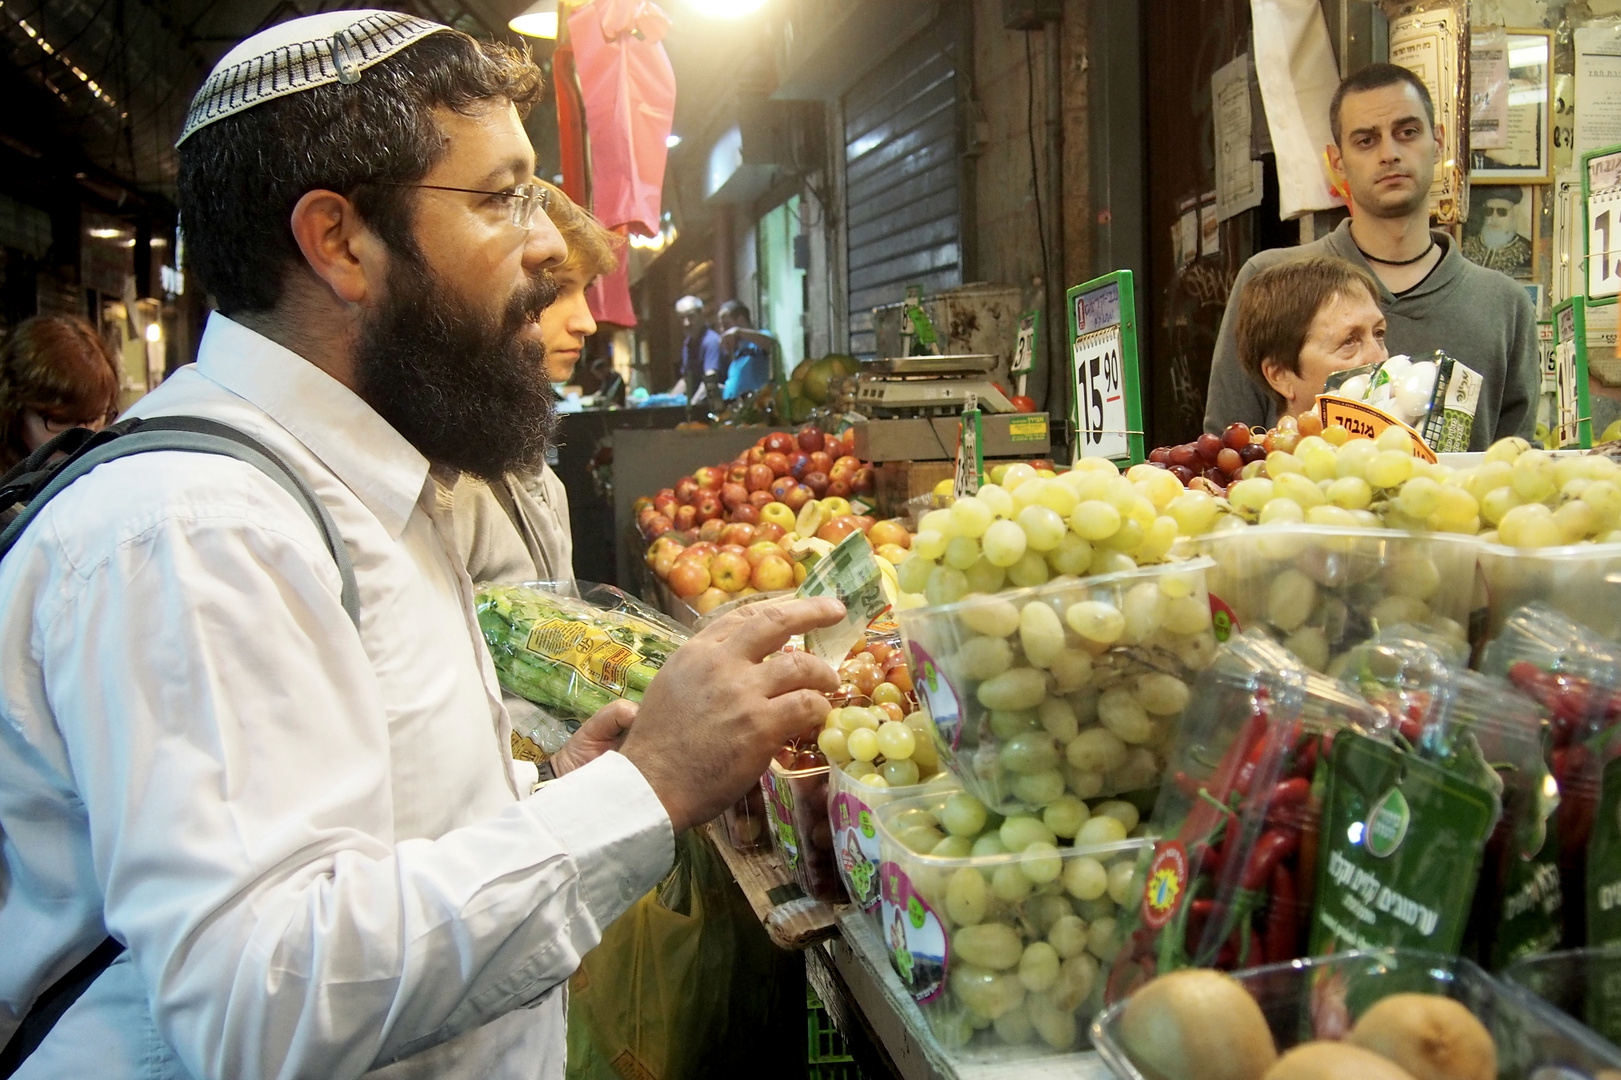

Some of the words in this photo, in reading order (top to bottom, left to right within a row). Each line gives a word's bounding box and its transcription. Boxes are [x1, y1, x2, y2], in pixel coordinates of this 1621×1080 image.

[1594, 209, 1621, 282] 1
[1078, 355, 1104, 446] 15
[1104, 348, 1118, 393] 90
[1335, 415, 1375, 439] מובחר
[861, 585, 886, 620] 20
